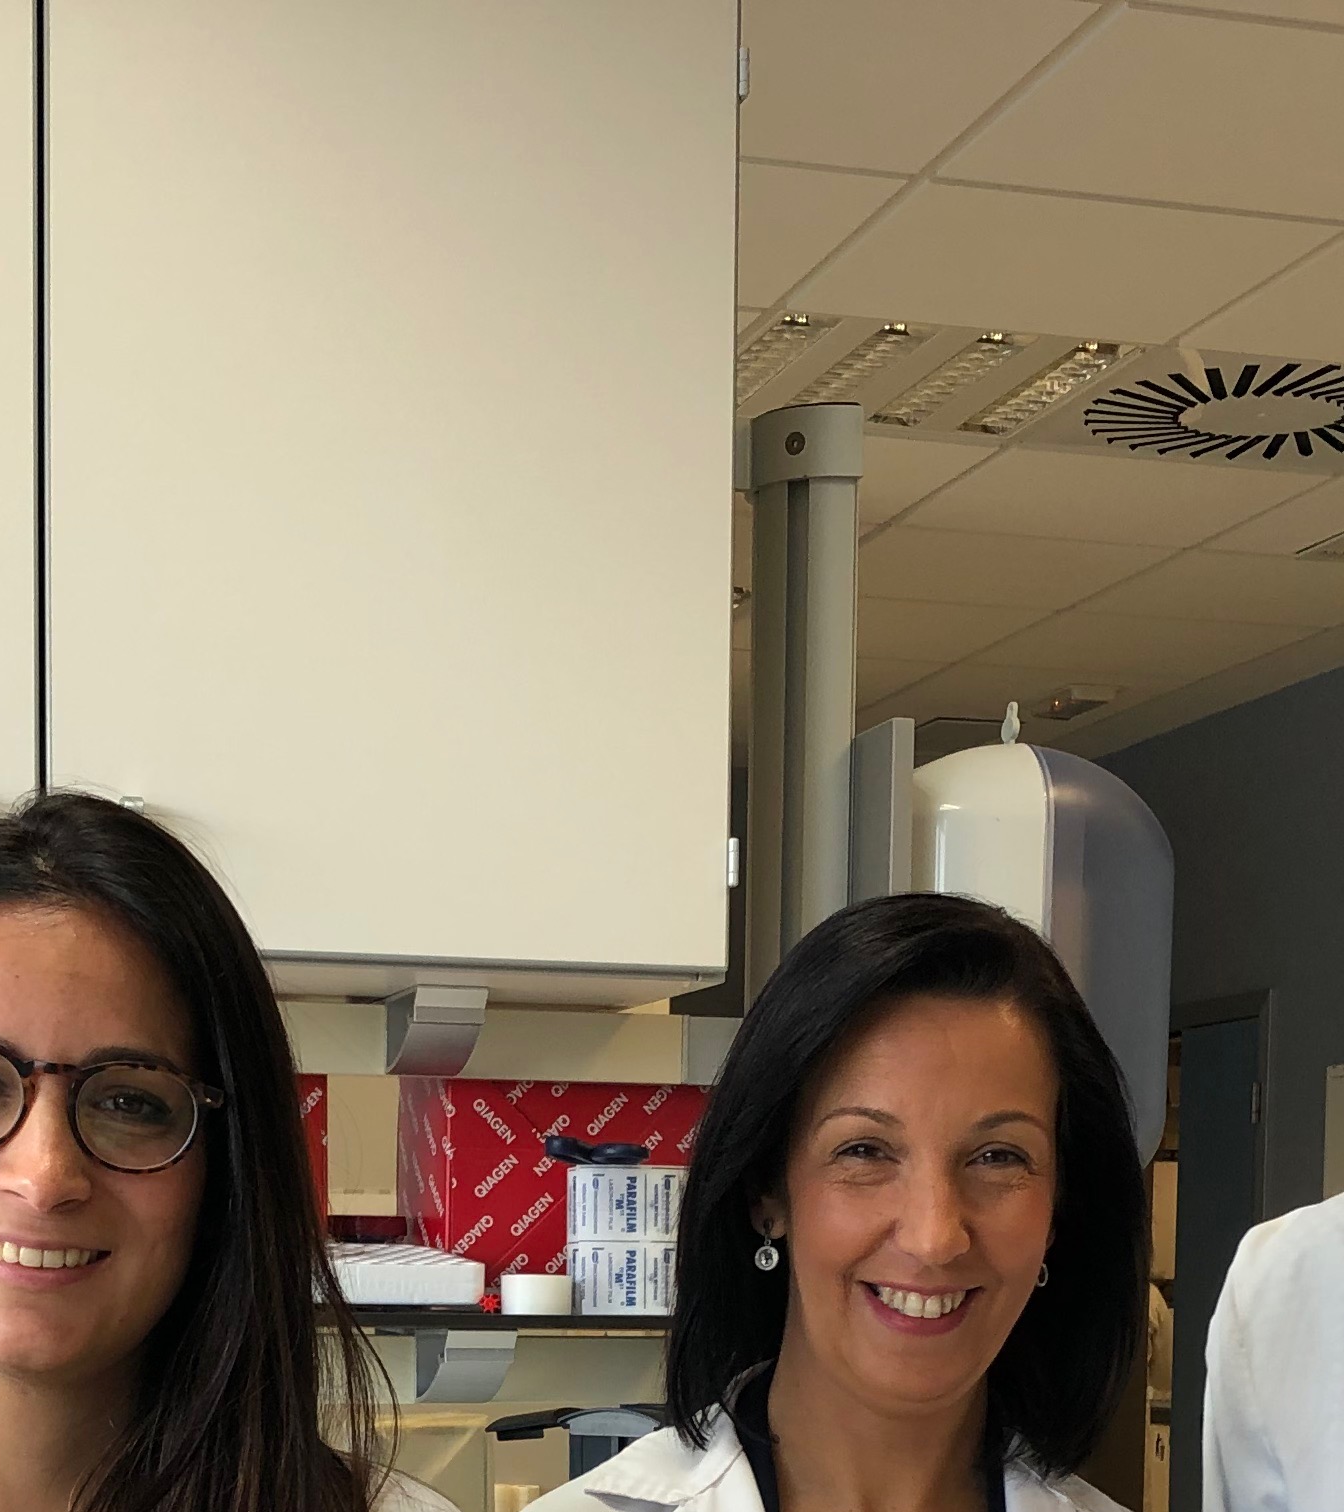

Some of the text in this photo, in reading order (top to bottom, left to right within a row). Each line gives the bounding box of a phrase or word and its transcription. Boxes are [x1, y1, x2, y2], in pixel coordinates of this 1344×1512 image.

[472, 1098, 517, 1145] QIAGEN
[586, 1092, 630, 1136] QIAGEN
[474, 1153, 520, 1198] QIAGEN
[510, 1192, 555, 1237] QIAGEN
[626, 1176, 638, 1233] PARAFILM
[452, 1214, 494, 1255] QIAGEN
[625, 1250, 637, 1307] PARAFILM
